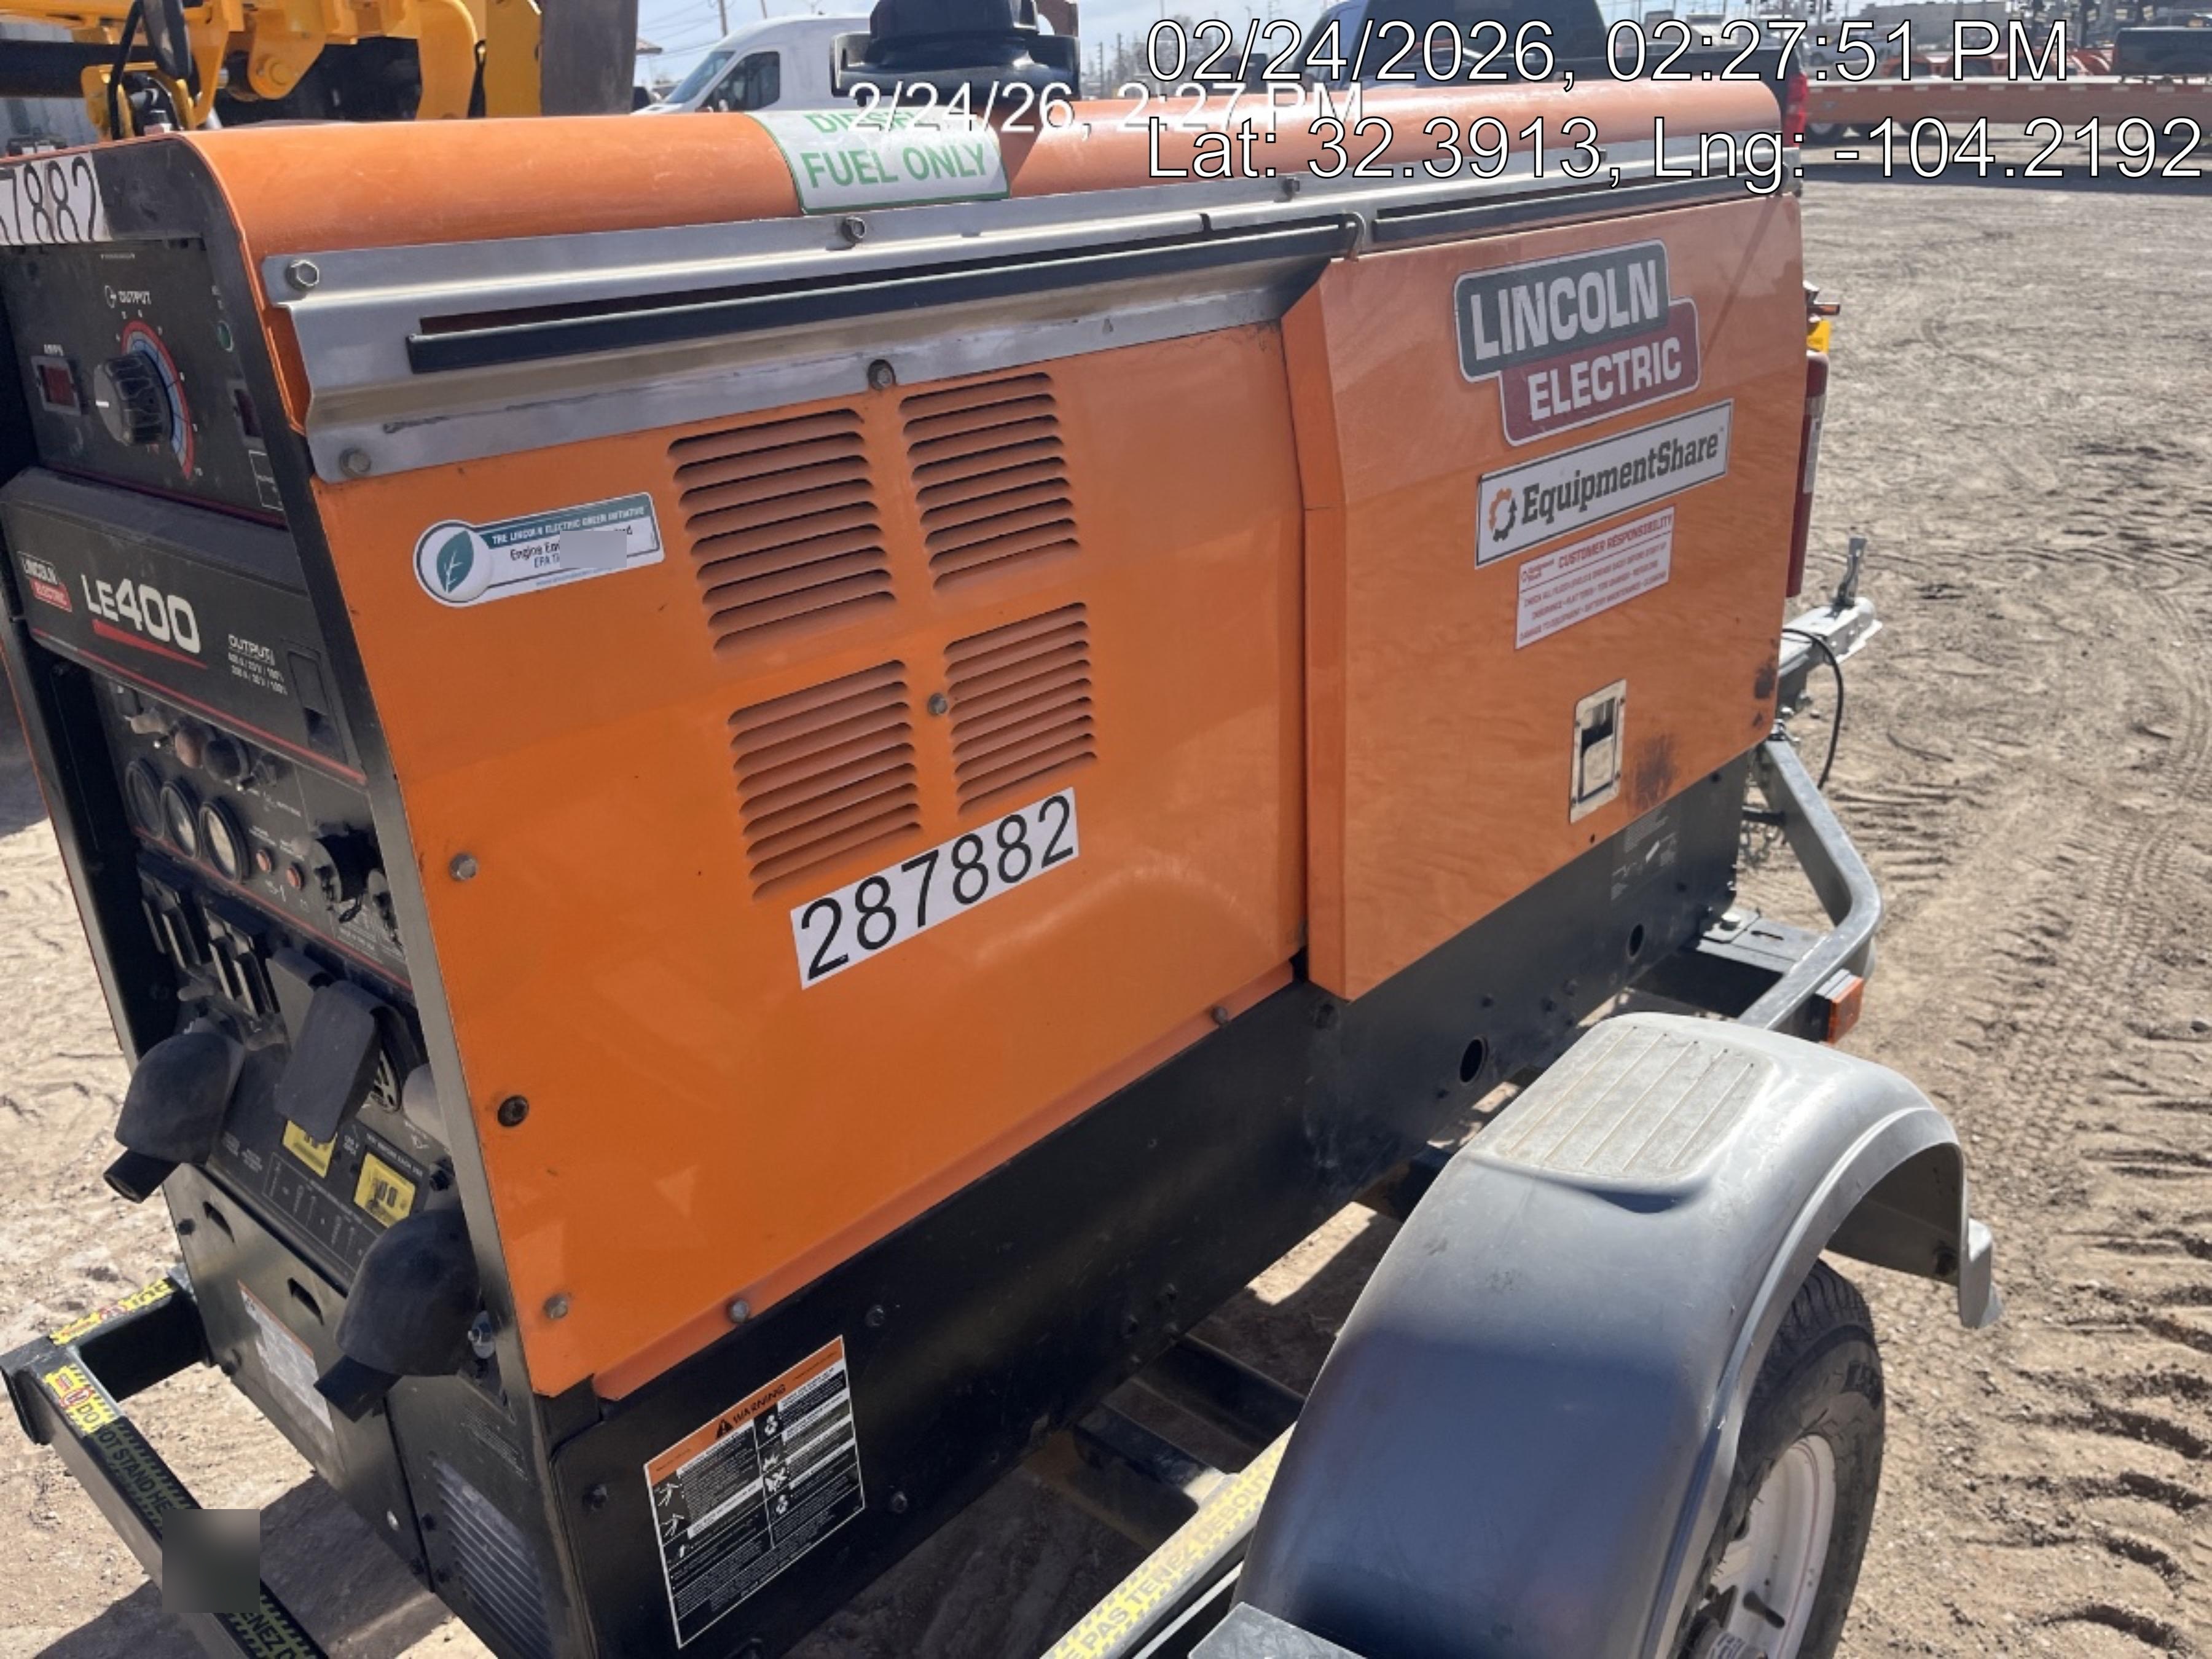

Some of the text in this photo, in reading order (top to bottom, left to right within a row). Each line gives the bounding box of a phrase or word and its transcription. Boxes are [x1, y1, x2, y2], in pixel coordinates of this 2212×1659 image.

[0, 156, 98, 245] 7882
[800, 143, 986, 188] FUEL ONLY
[1470, 259, 1660, 361] LINCOLN
[1527, 337, 1683, 422] ELECTRIC
[1521, 431, 1720, 526] EquipmentShare
[510, 545, 543, 561] Engine
[1558, 539, 1606, 568] CUSTOMER
[1606, 514, 1673, 549] RESPONSIBILITY
[80, 574, 201, 654] LE400
[801, 795, 1074, 981] 287882
[732, 1384, 786, 1425] WARNING
[76, 1403, 101, 1424] DO
[112, 1448, 156, 1492] STAND
[1080, 1606, 1129, 1652] PAS
